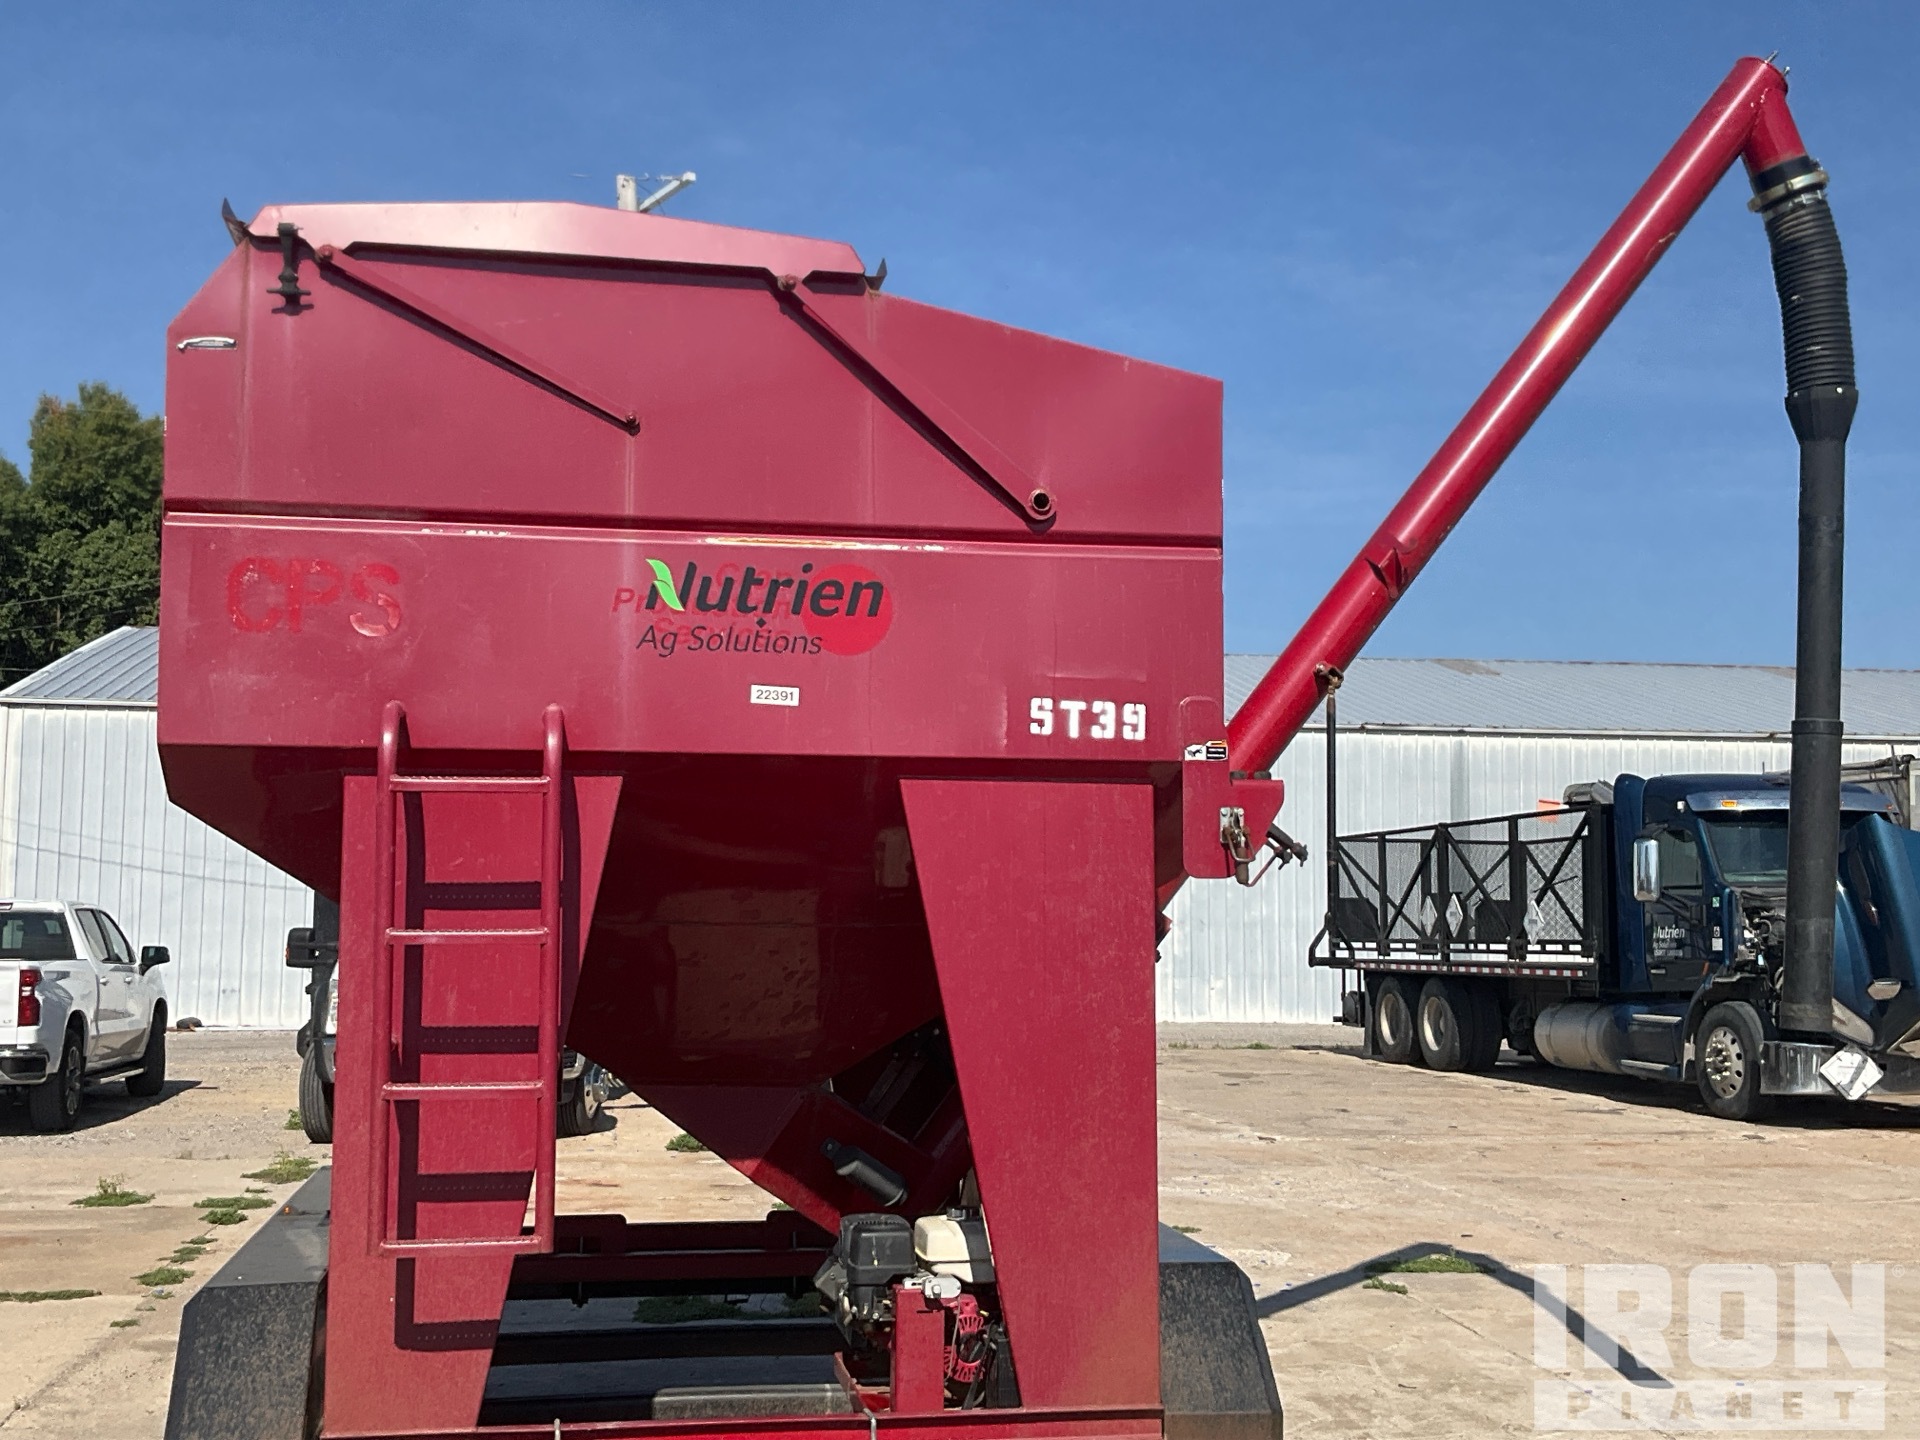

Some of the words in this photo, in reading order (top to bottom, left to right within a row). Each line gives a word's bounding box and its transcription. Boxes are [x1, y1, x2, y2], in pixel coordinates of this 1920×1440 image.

[226, 557, 402, 637] CPS
[645, 558, 884, 618] Nutrien
[636, 625, 678, 658] Ag
[687, 625, 823, 655] Solutions
[755, 688, 794, 702] 22391
[1029, 697, 1147, 741] ST39
[1652, 923, 1686, 940] Nutrien
